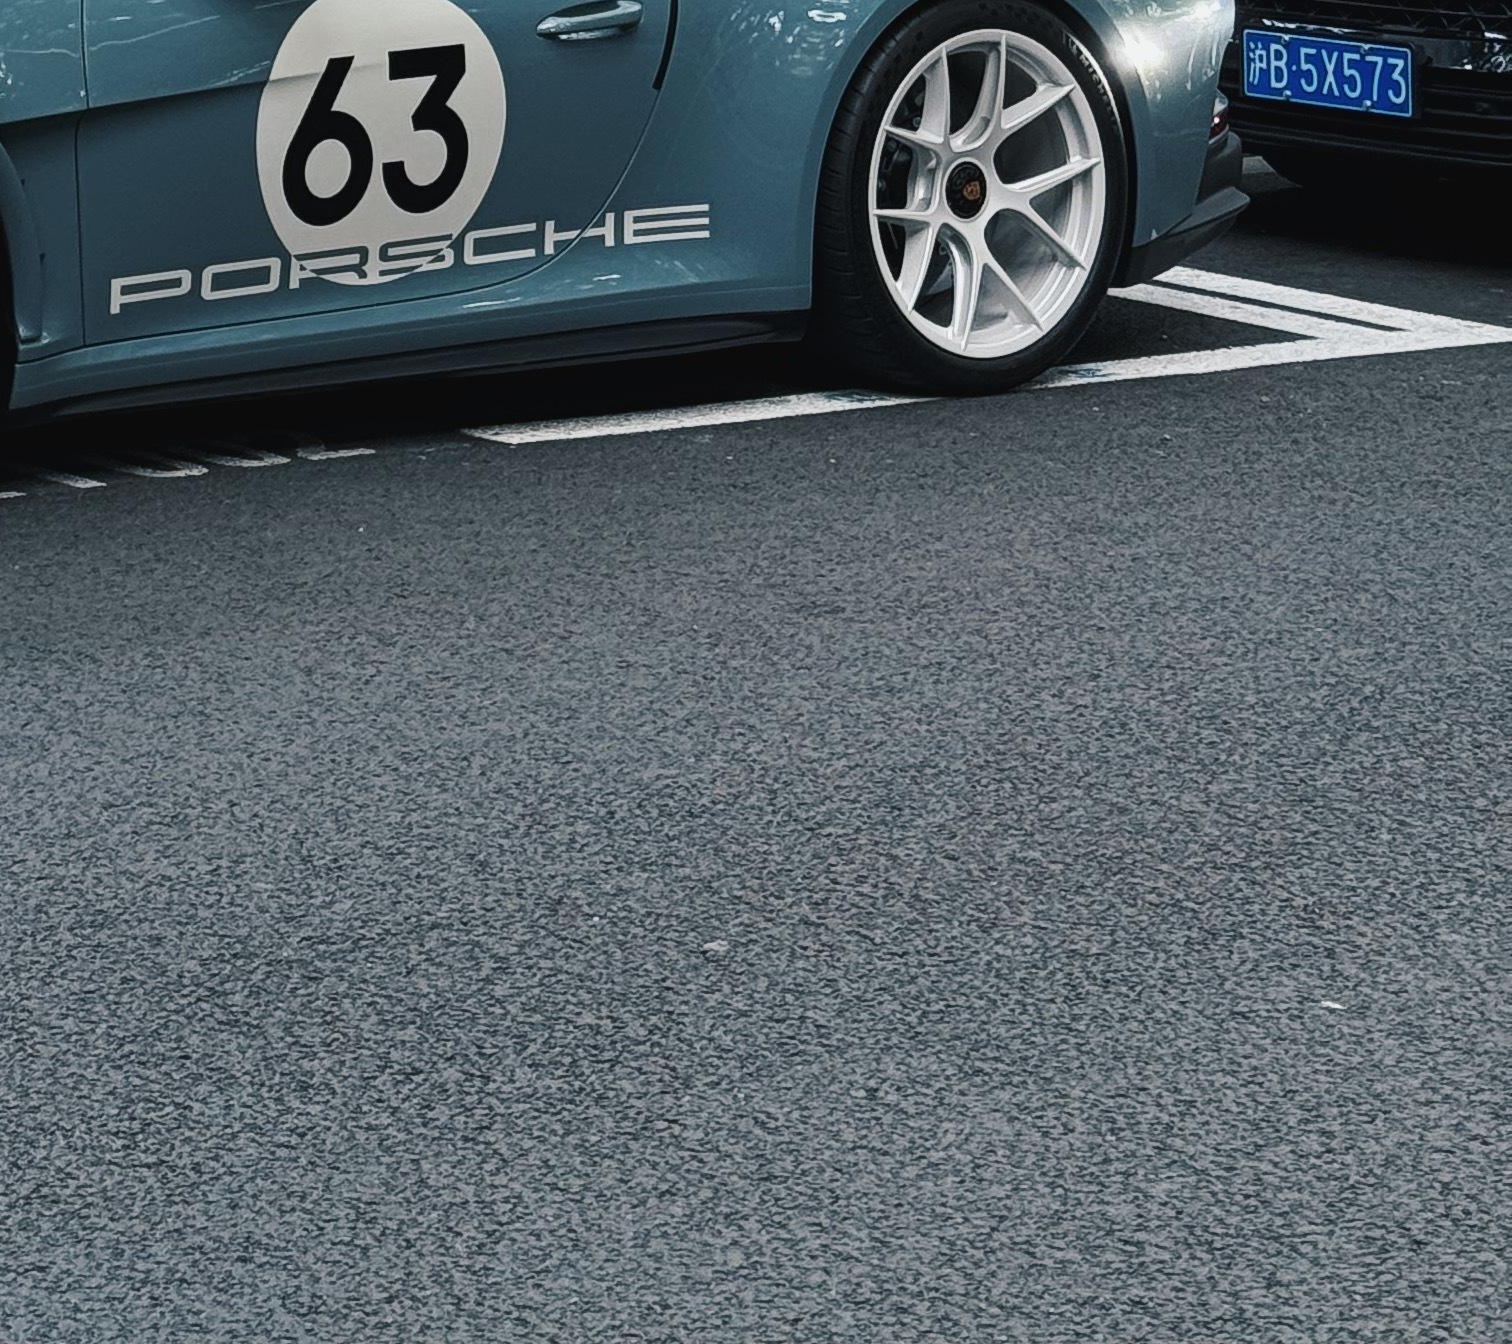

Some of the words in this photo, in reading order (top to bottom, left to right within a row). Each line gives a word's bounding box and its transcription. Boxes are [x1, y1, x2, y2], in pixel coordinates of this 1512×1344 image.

[1249, 40, 1407, 104] 沪B·5X573
[282, 43, 469, 226] 63
[109, 203, 710, 314] PORSCHE
